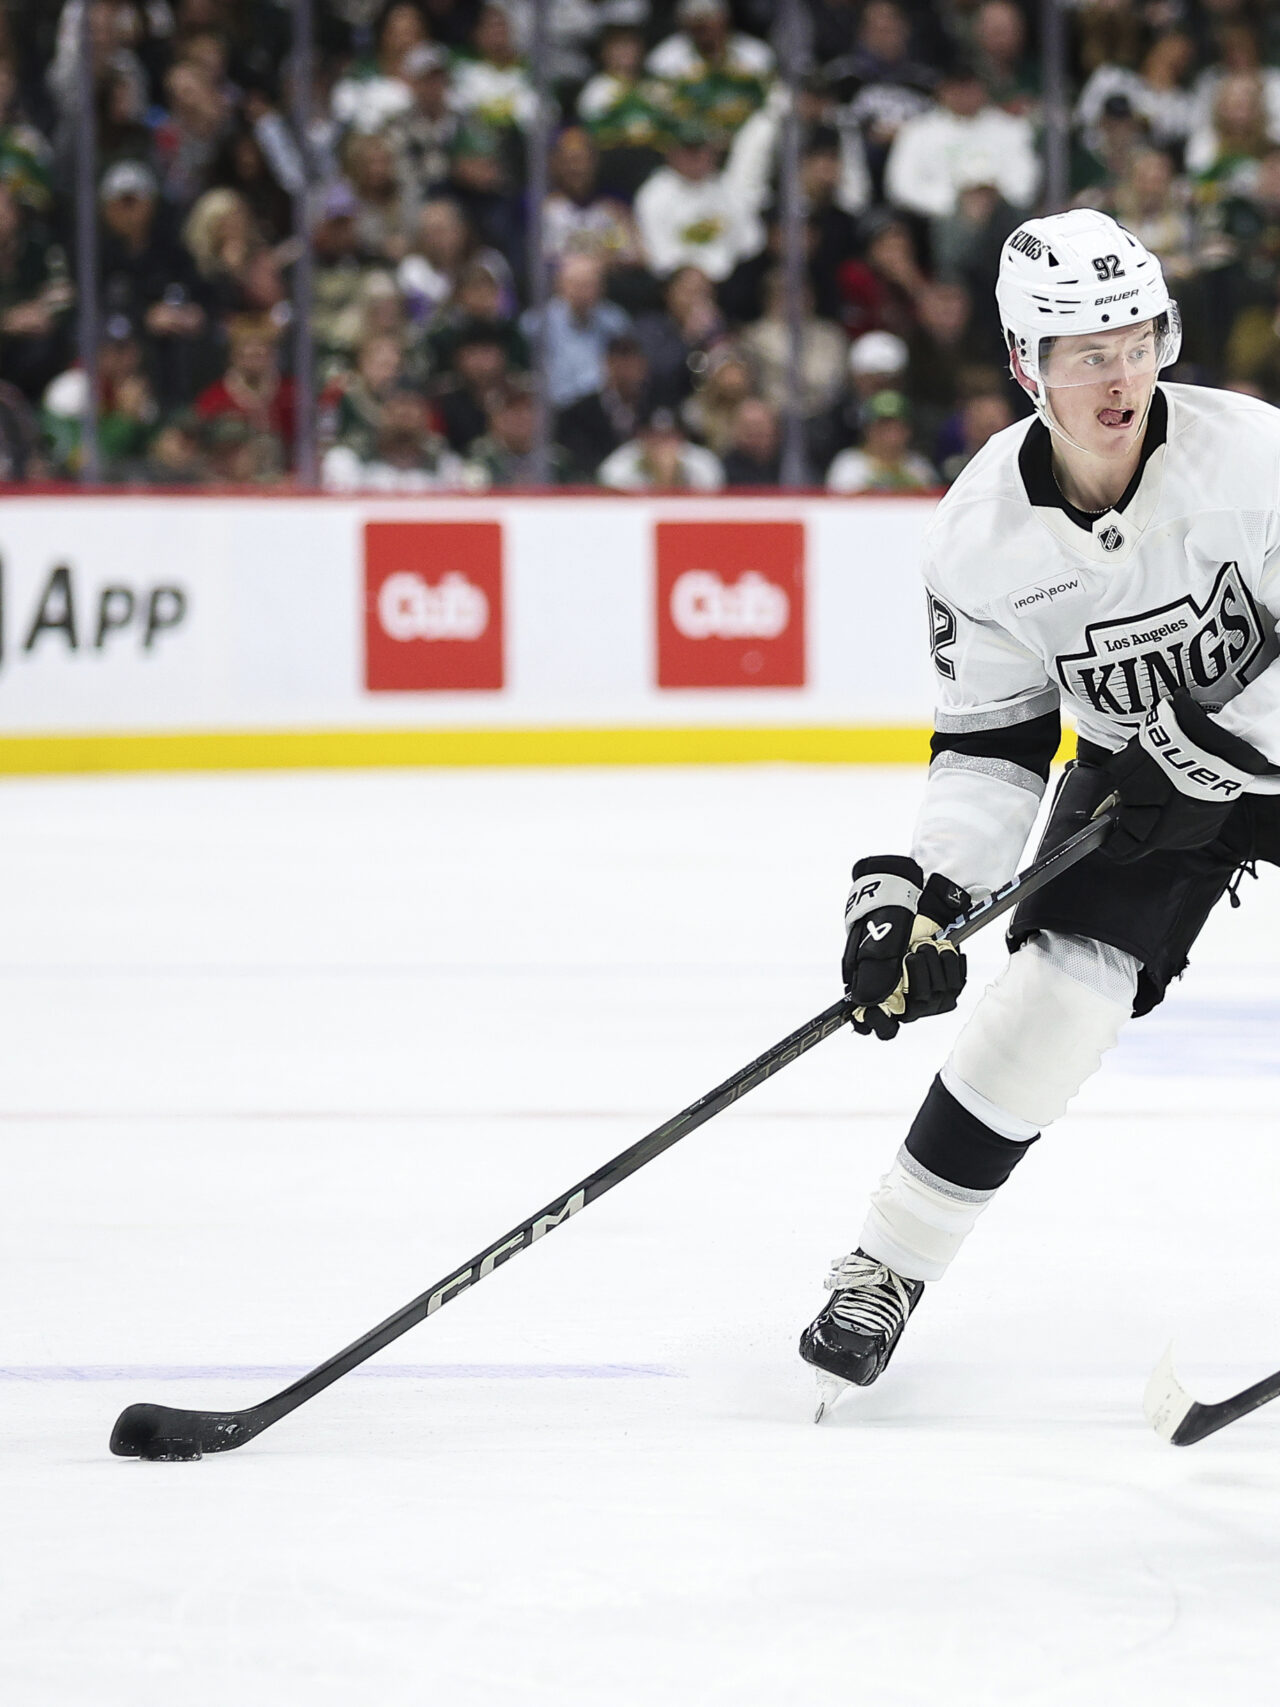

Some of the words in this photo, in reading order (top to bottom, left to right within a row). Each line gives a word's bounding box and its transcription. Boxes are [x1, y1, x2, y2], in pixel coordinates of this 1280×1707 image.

[1008, 230, 1051, 261] KINGS
[1092, 254, 1125, 281] 92
[1094, 288, 1140, 306] BAUER
[378, 571, 490, 642] Cub
[670, 569, 790, 640] Cub
[1014, 592, 1045, 610] IRON
[1048, 579, 1079, 597] BOW
[1077, 584, 1251, 716] KINGS
[1104, 637, 1131, 653] Los
[1131, 618, 1189, 646] Angeles
[1146, 708, 1242, 797] BAUER
[427, 1187, 586, 1317] CCM
